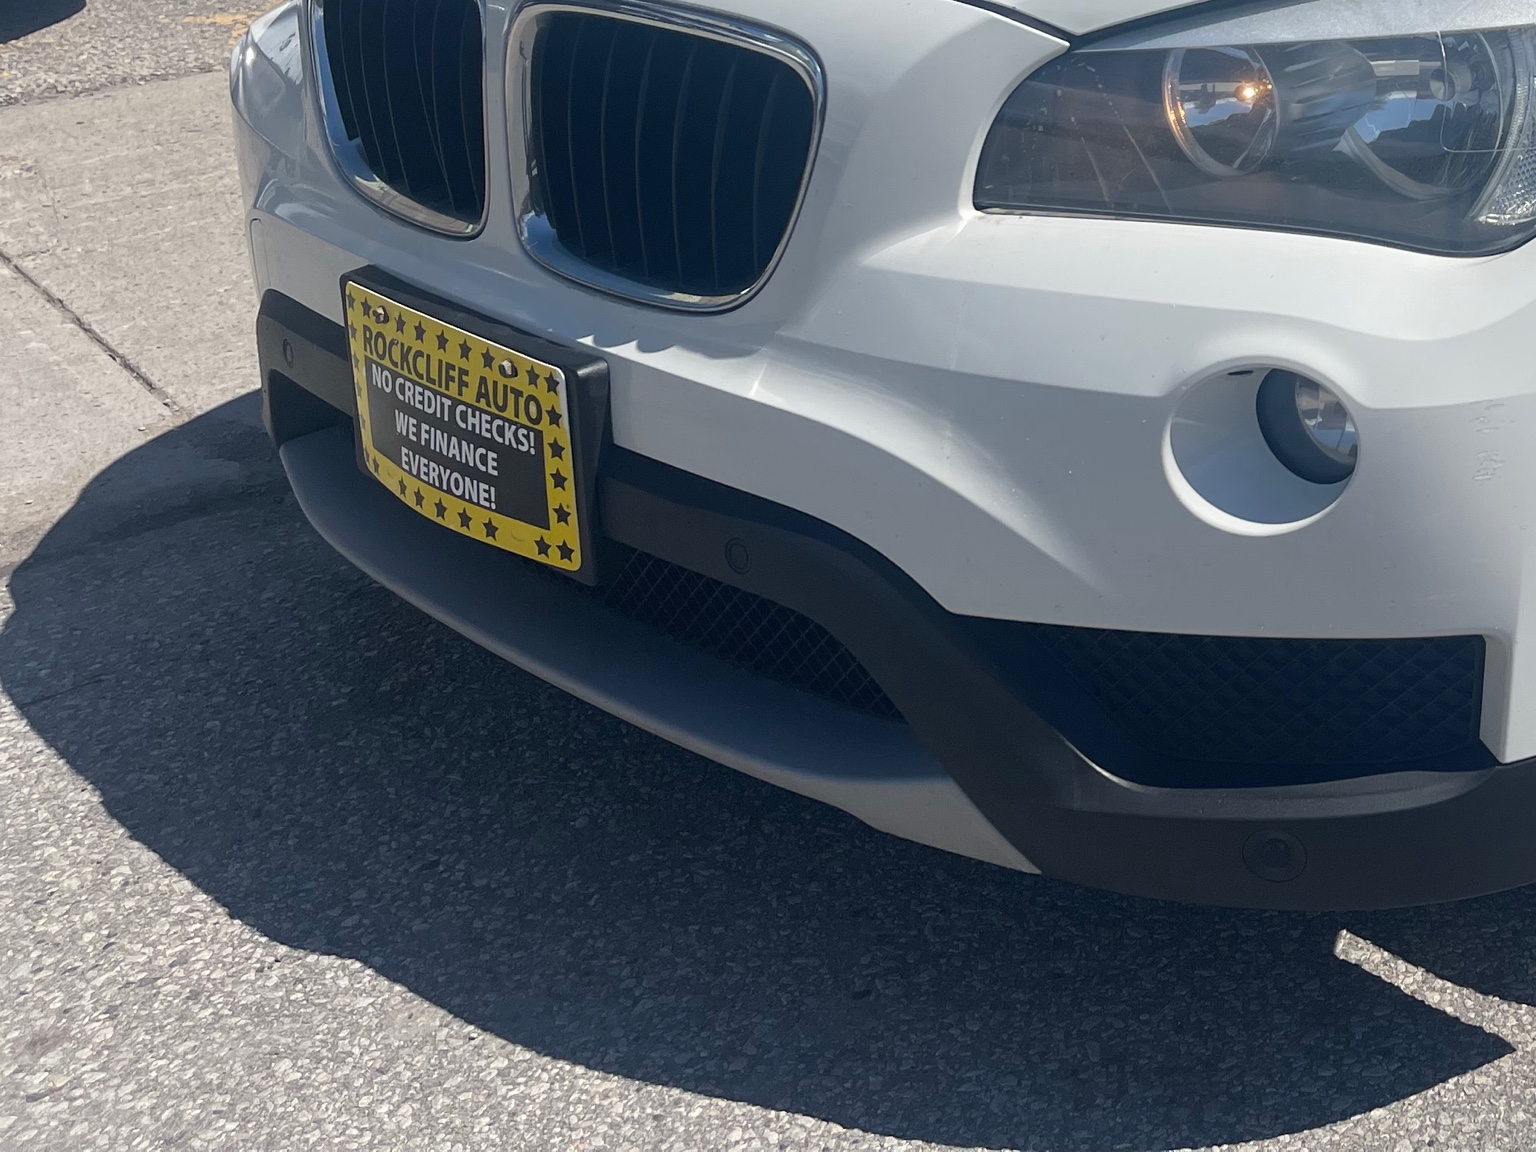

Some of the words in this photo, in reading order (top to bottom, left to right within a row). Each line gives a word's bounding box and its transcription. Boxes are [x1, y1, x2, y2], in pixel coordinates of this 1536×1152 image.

[362, 323, 470, 398] ROCKCLIFF
[475, 375, 543, 426] AUTO
[371, 363, 393, 394] NO
[395, 377, 452, 422] CREDIT
[455, 404, 536, 456] CHECKS!
[394, 408, 418, 443] WE
[420, 422, 499, 477] FINANCE
[401, 445, 497, 510] EVERYONE!
